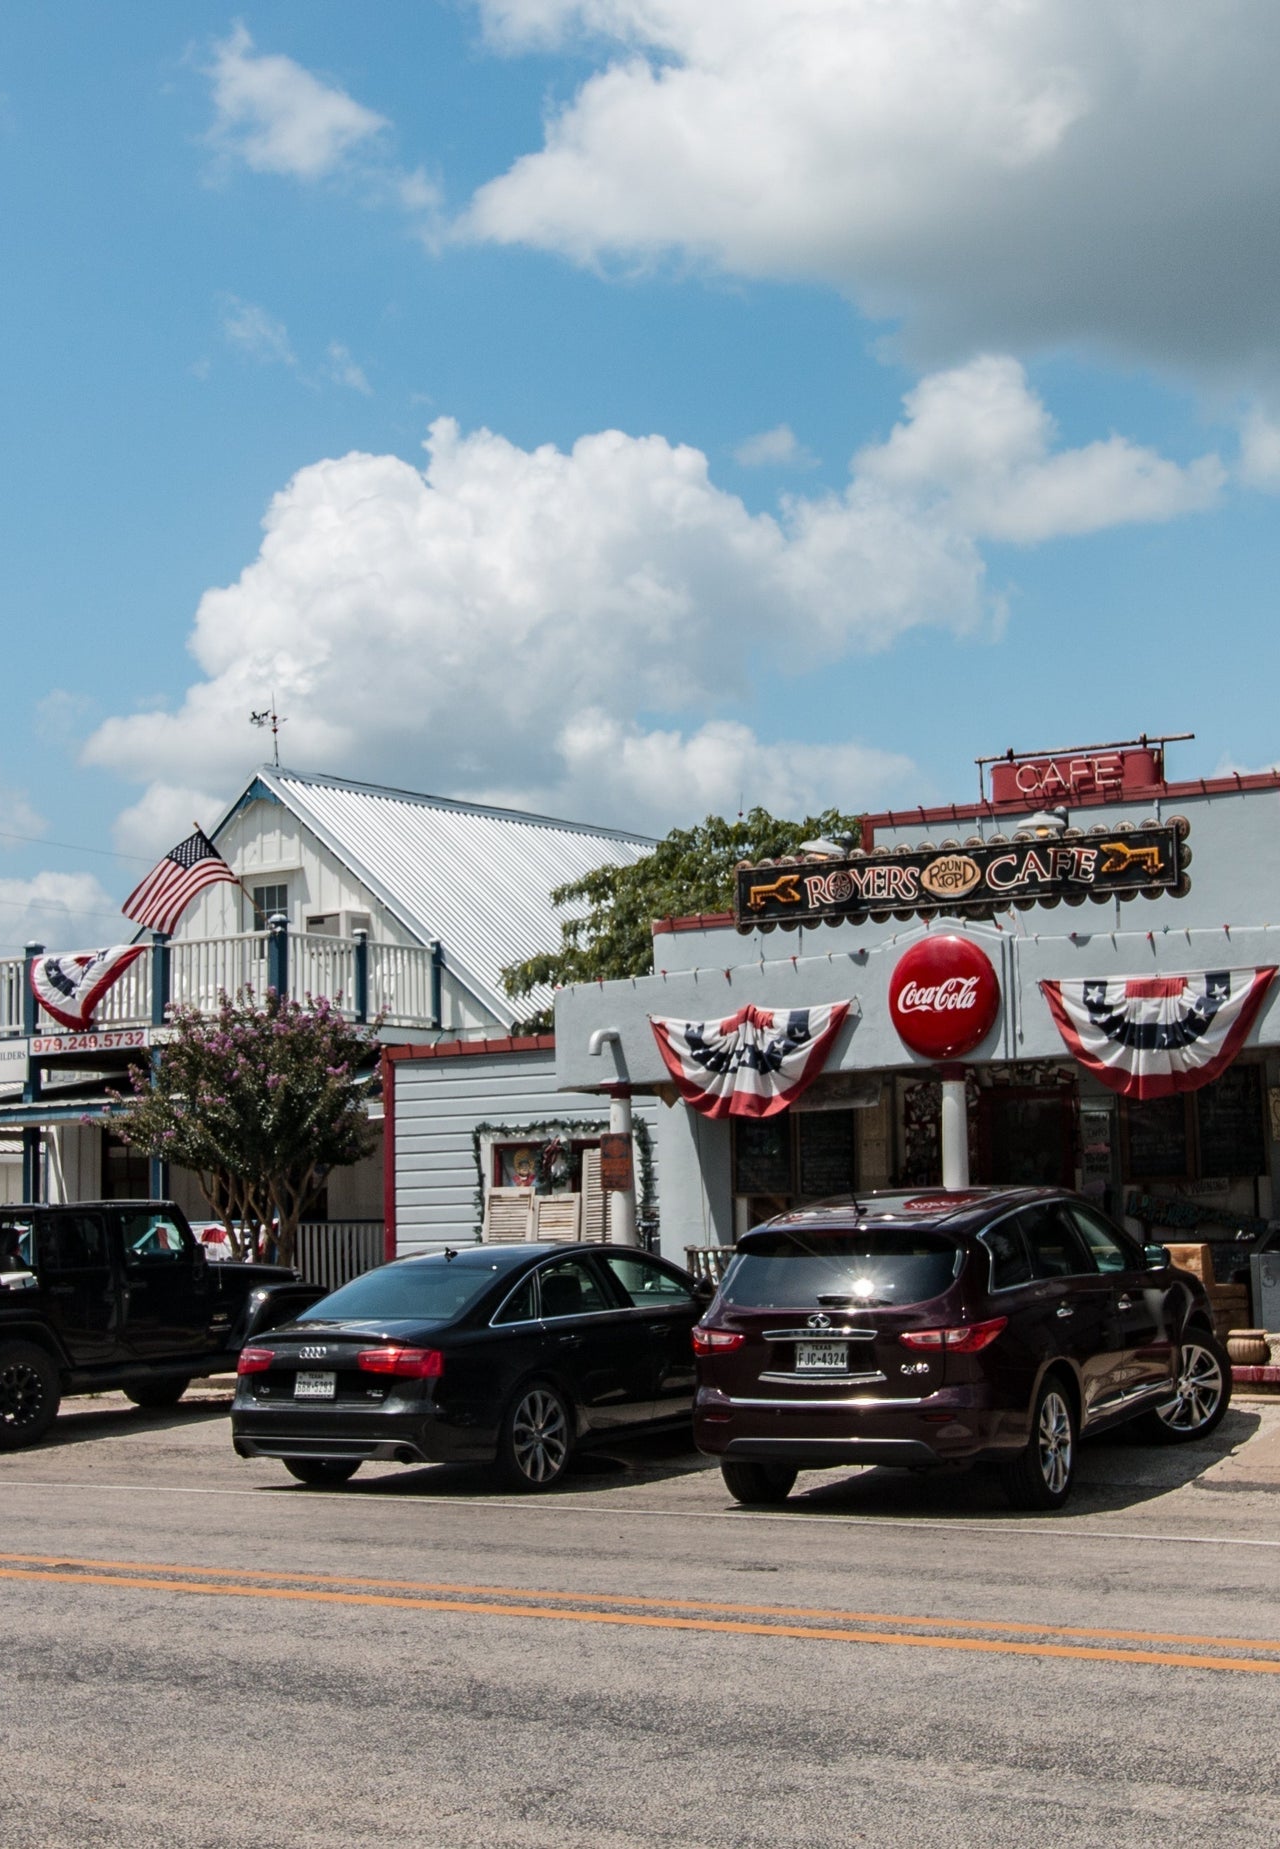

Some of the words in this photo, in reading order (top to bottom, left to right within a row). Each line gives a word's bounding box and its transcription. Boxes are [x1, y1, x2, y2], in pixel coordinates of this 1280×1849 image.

[1015, 755, 1119, 793] CAFE
[805, 865, 920, 909] ROYERS
[985, 846, 1099, 891] CAFE
[928, 860, 976, 888] ROUND
[938, 872, 963, 888] TOP
[897, 976, 980, 1014] Coca-Cola
[32, 1032, 145, 1053] 979.249.5732
